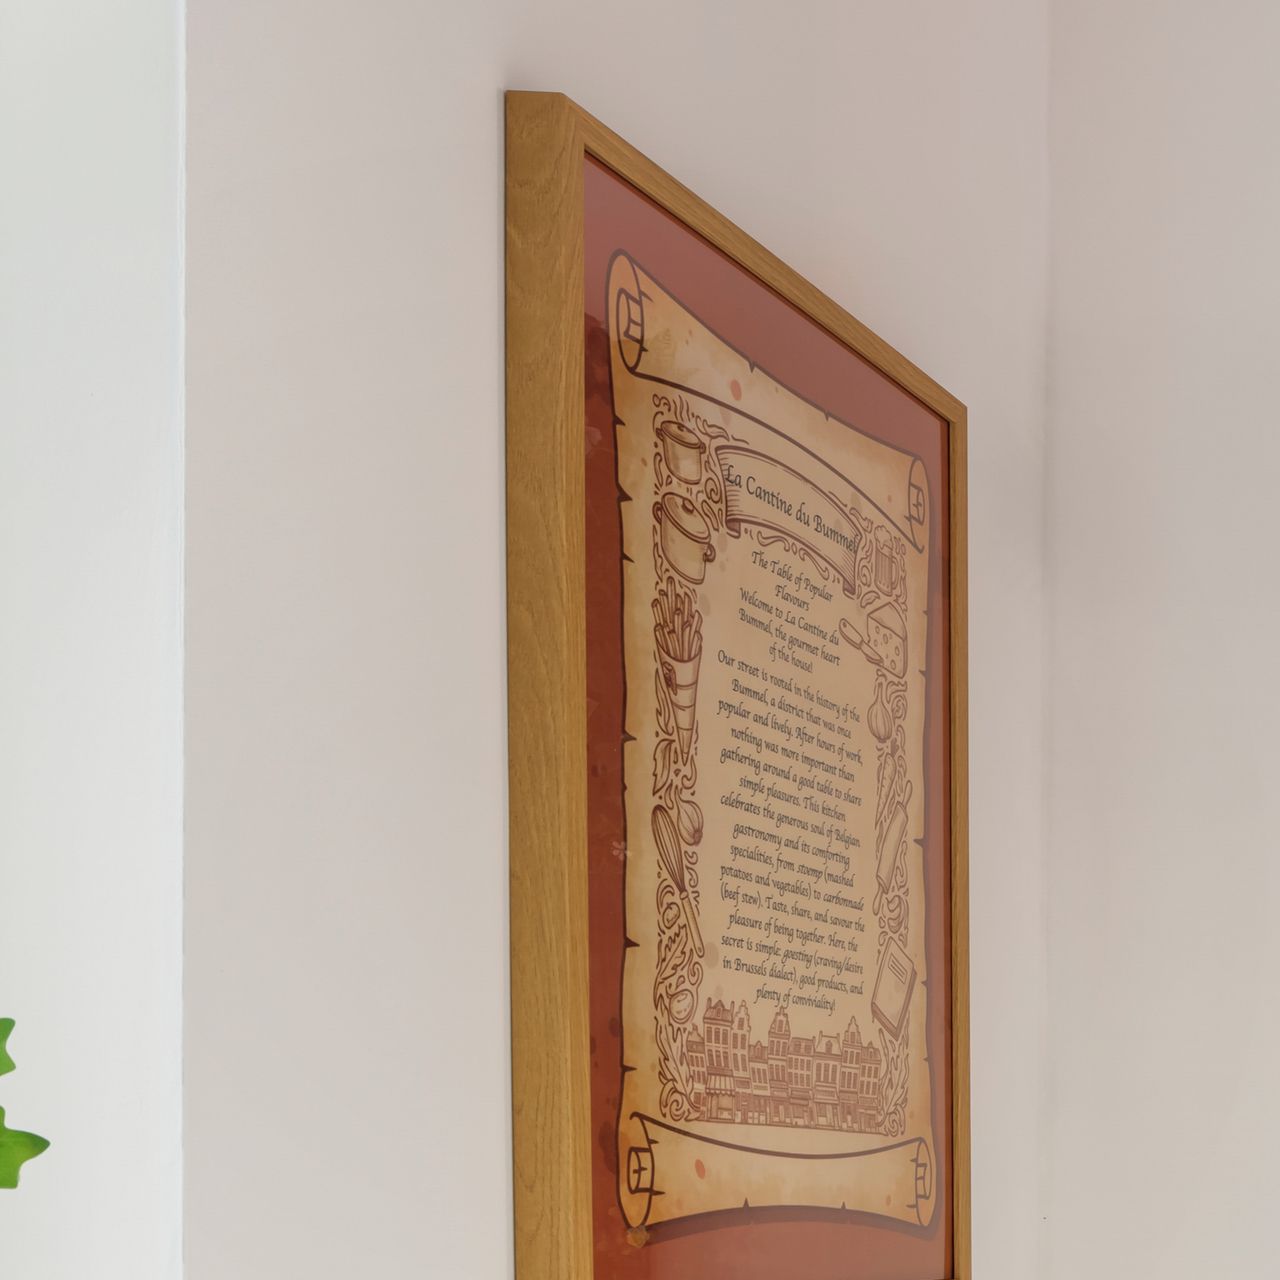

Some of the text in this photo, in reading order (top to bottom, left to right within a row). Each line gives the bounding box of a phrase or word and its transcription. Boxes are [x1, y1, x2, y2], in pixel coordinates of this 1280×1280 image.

[726, 465, 858, 553] La Cantine du Bummel
[752, 551, 833, 602] The Table of Popular
[775, 585, 809, 611] Flavours
[739, 608, 840, 666] Bummel, the gourmet heart
[740, 587, 839, 646] Welcome to La Cantine du
[769, 642, 777, 662] of
[778, 646, 789, 662] the
[718, 650, 860, 723] Our street is rooted in the history of the
[732, 679, 768, 706] Bummel,
[771, 697, 776, 707] a
[778, 696, 804, 719] district
[806, 708, 821, 726] that
[823, 719, 835, 731] was
[717, 700, 751, 719] popular
[753, 712, 770, 727] and
[771, 714, 793, 741] lively.
[796, 726, 815, 746] After
[817, 732, 835, 754] hours
[838, 742, 845, 761] of
[731, 727, 855, 782] nothing was more important than
[720, 746, 862, 806] gathering around a good table to share
[739, 776, 765, 797] simple
[803, 796, 820, 813] This
[822, 800, 846, 822] kitchen
[721, 792, 761, 815] celebrates
[763, 803, 775, 819] the
[776, 813, 808, 831] generous
[811, 822, 825, 836] soul
[827, 824, 833, 845] of
[733, 823, 850, 874] gastronomy and its comforting
[775, 853, 794, 873] from
[824, 866, 855, 887] (mashed
[720, 865, 752, 882] potatoes
[755, 872, 771, 887] and
[814, 888, 821, 900] to
[721, 882, 741, 907] (beef
[765, 895, 790, 916] Taste,
[814, 909, 829, 924] and
[830, 916, 853, 929] savour
[855, 917, 865, 932] the
[721, 934, 744, 948] secret
[747, 938, 752, 950] is
[727, 909, 762, 930] pleasure
[764, 917, 773, 938] of
[774, 918, 794, 943] being
[796, 928, 826, 946] together.
[848, 937, 858, 951] the
[723, 956, 731, 969] in
[734, 958, 767, 976] Brussels
[799, 972, 816, 989] good
[850, 981, 864, 995] and
[753, 983, 782, 1007] plenty
[783, 988, 792, 1008] of
